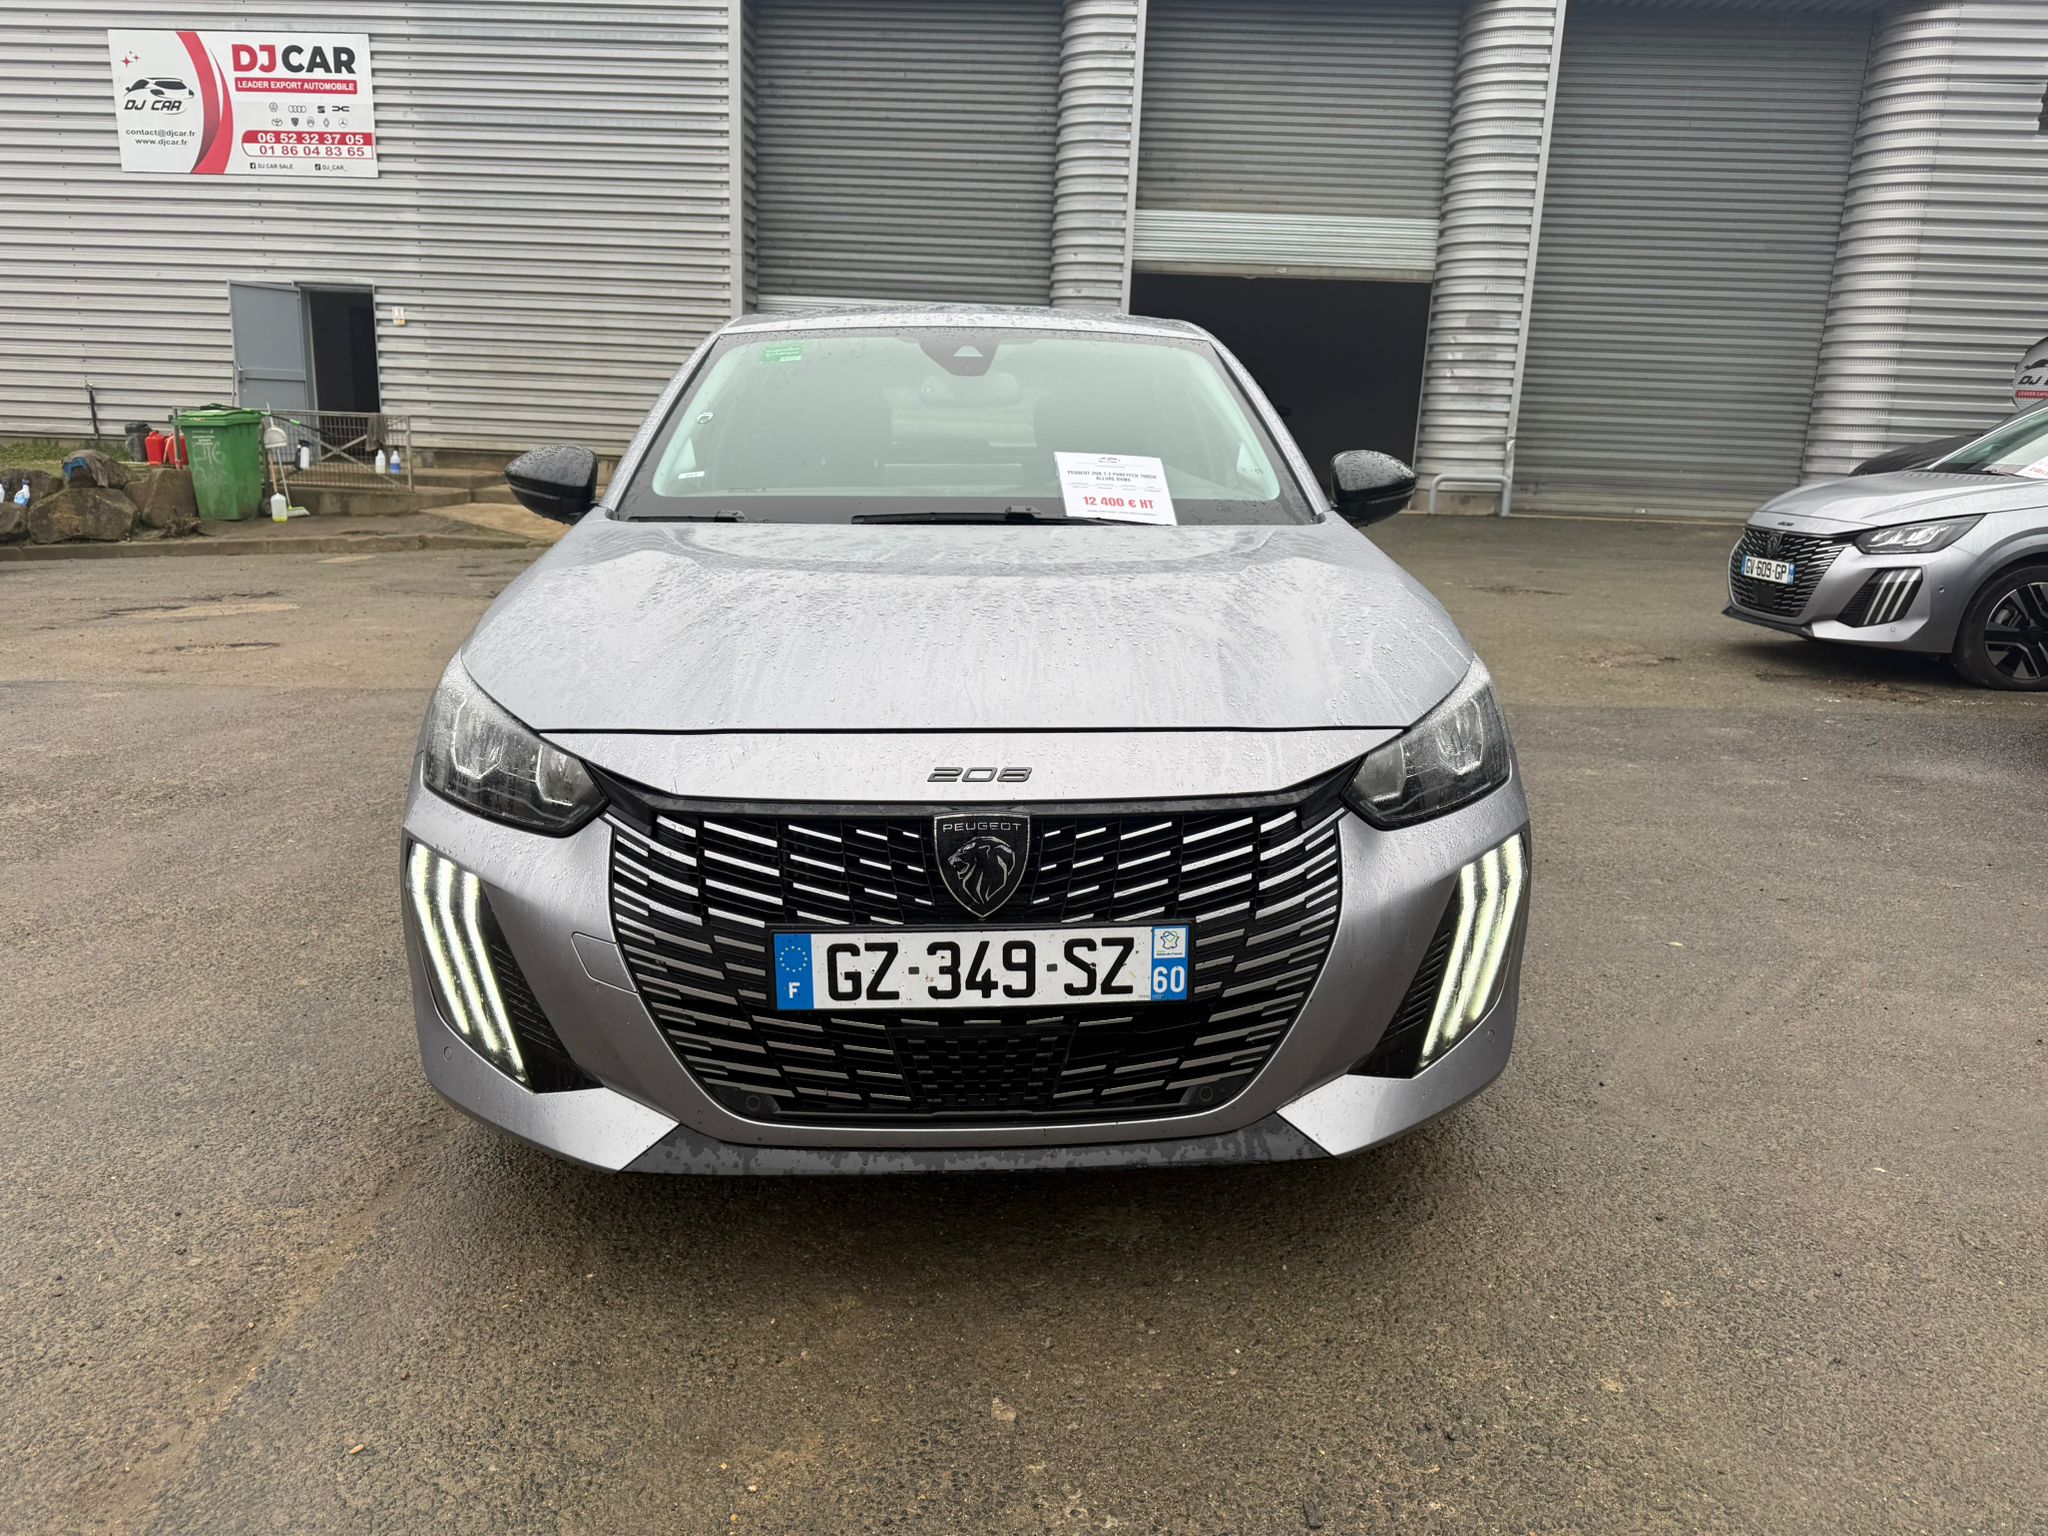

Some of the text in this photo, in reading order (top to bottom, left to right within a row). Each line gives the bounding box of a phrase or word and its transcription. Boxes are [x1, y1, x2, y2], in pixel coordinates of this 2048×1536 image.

[231, 44, 357, 75] DJ CAR
[238, 81, 354, 91] LEADER EXPORT AUTOMOBILE
[124, 99, 183, 111] DJ CAR
[125, 129, 196, 138] contact@djcar.fr
[257, 132, 364, 145] 06 52 32 37 05
[135, 138, 188, 147] www.djcar.fr
[259, 145, 365, 157] 01 86 04 83 65
[2018, 376, 2043, 385] DJ
[1083, 496, 1154, 510] 12 400 € HT
[927, 766, 1032, 782] 208
[942, 822, 1022, 832] PEUGEOT
[788, 937, 1135, 1001] F GZ-349-SZ
[1153, 965, 1185, 993] 60
